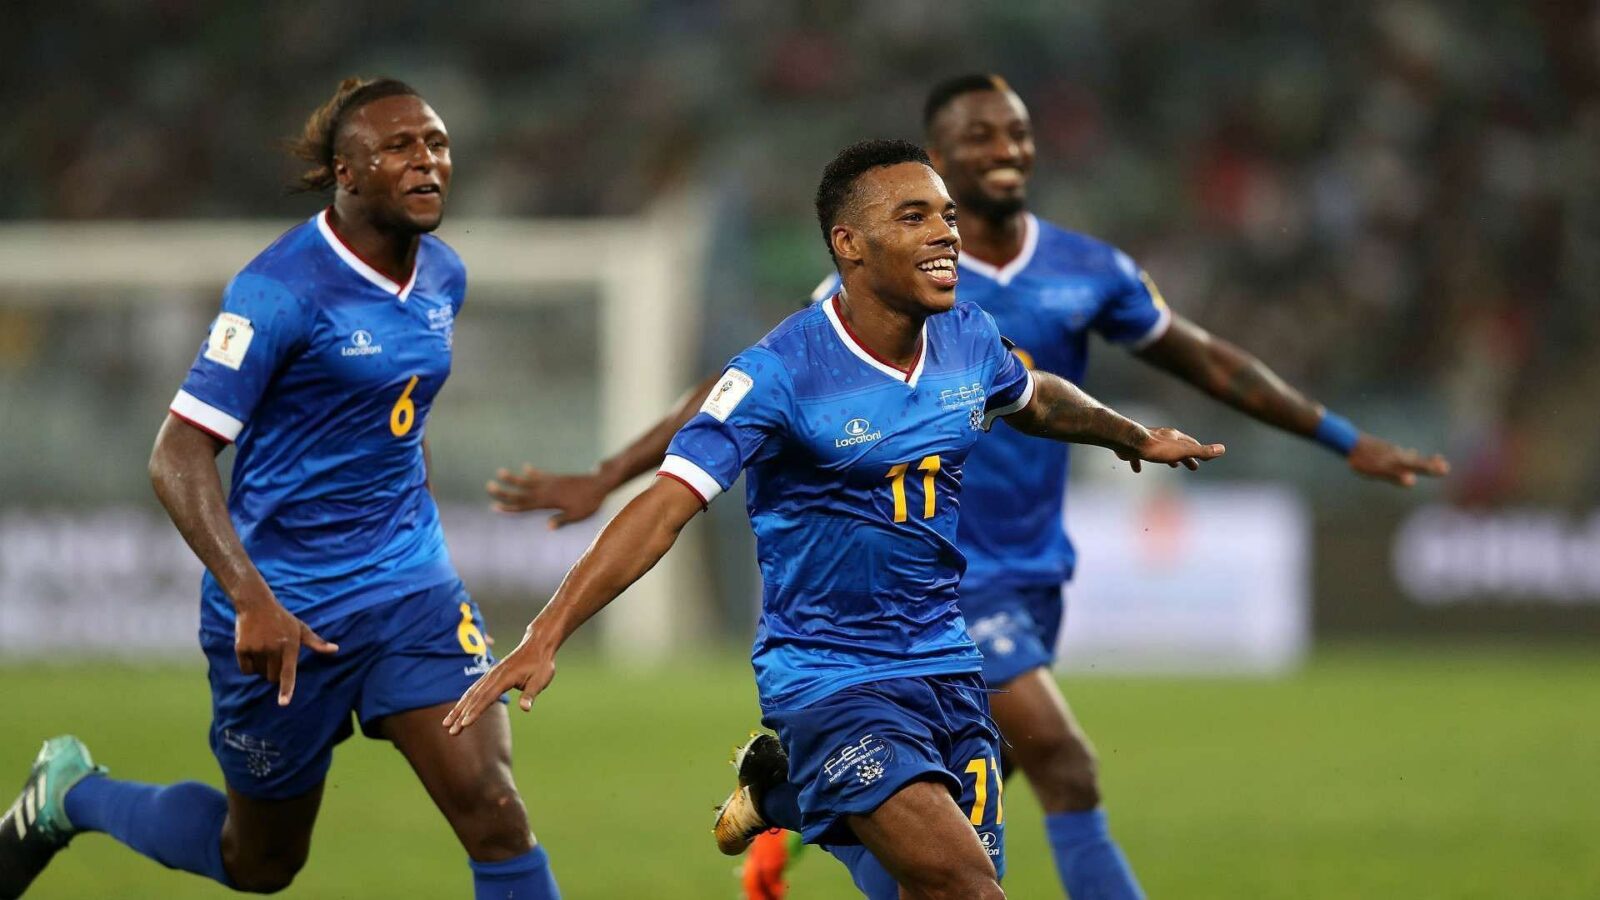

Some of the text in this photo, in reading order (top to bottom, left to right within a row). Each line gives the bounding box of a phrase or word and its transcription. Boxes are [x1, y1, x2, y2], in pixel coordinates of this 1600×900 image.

[390, 374, 419, 437] 6
[835, 430, 882, 448] Lacatoni
[885, 455, 941, 523] 11
[457, 602, 487, 655] 6
[964, 757, 1004, 826] 11
